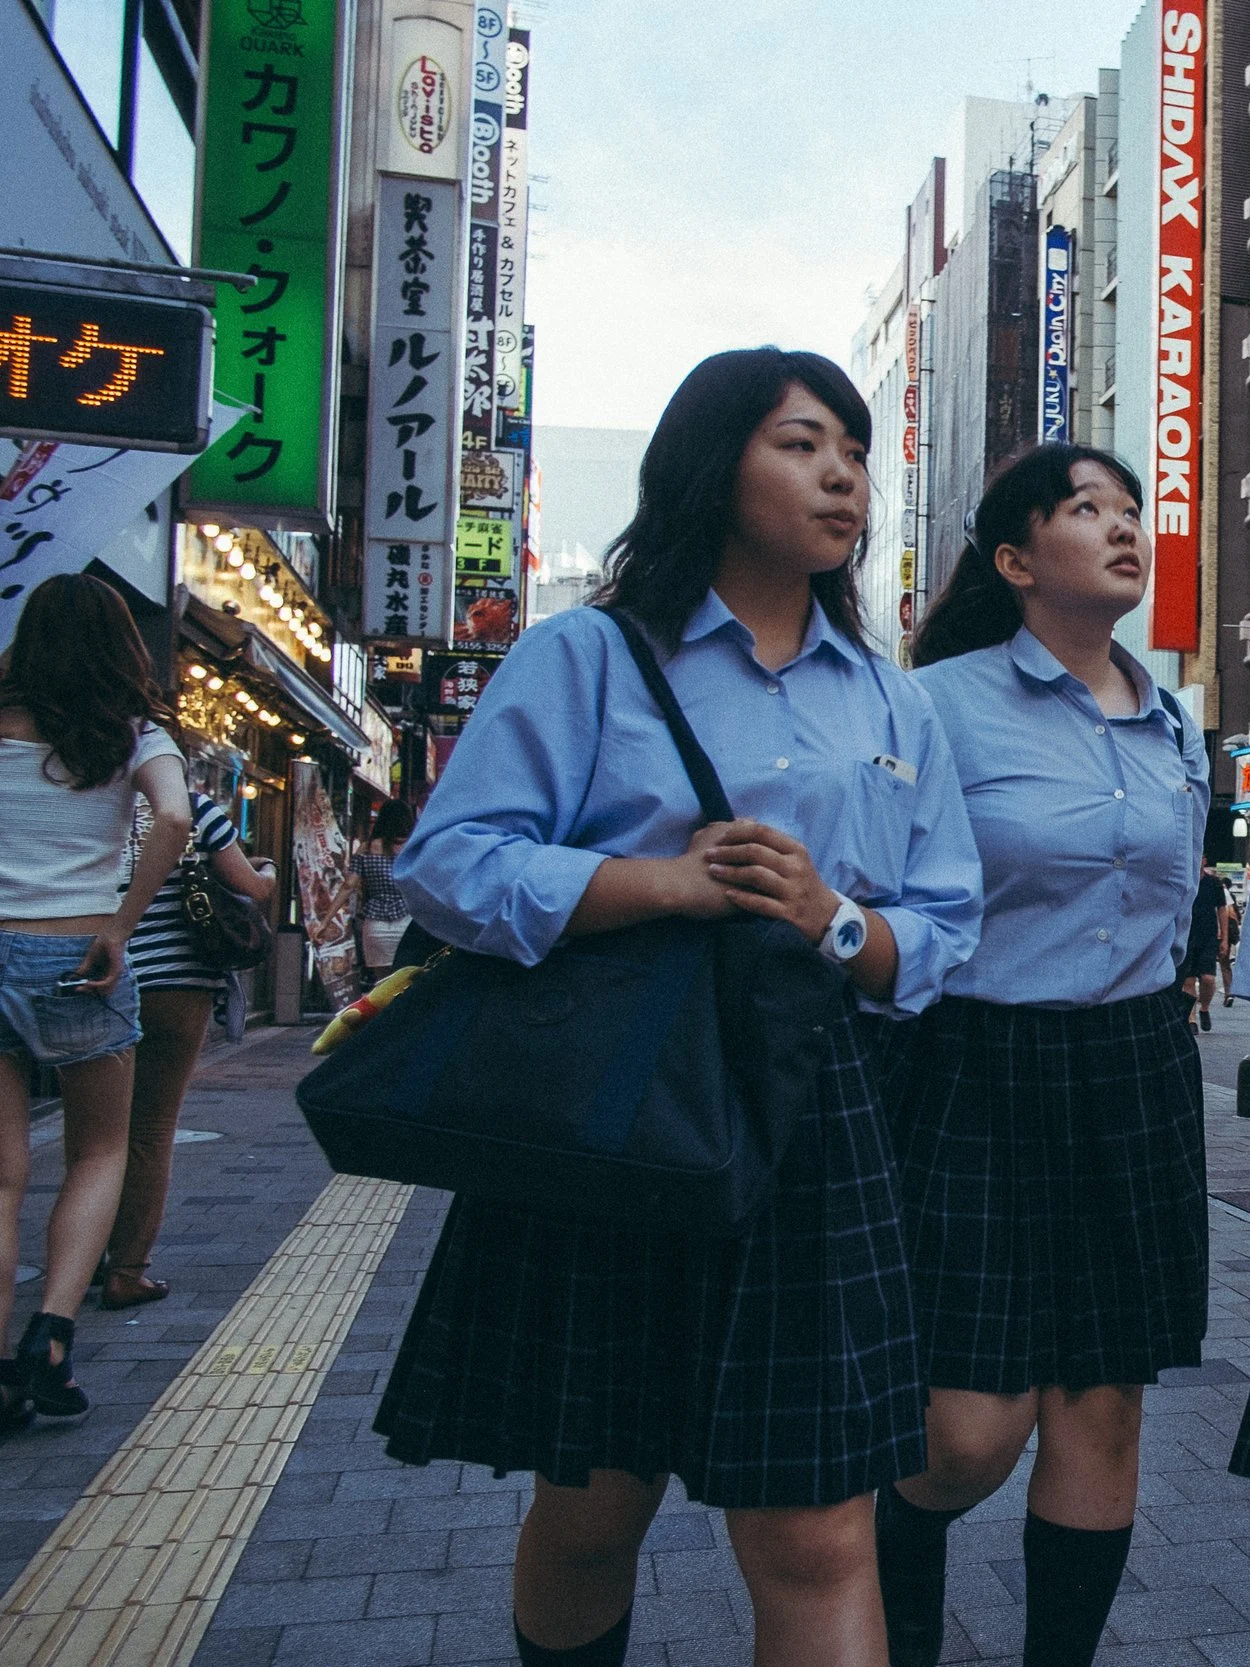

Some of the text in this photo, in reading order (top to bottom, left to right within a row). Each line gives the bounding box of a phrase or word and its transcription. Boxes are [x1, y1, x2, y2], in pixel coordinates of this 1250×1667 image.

[240, 36, 305, 58] QUARK
[226, 63, 298, 483] カワノ・クォーク
[399, 193, 433, 317] 喫茶室
[501, 236, 514, 249] &
[499, 258, 514, 318] カプセル
[1158, 11, 1201, 538] SHIDAX KARAOKE
[384, 332, 440, 522] ルノアール
[462, 430, 487, 450] 4F
[1045, 380, 1064, 443] INJUKU
